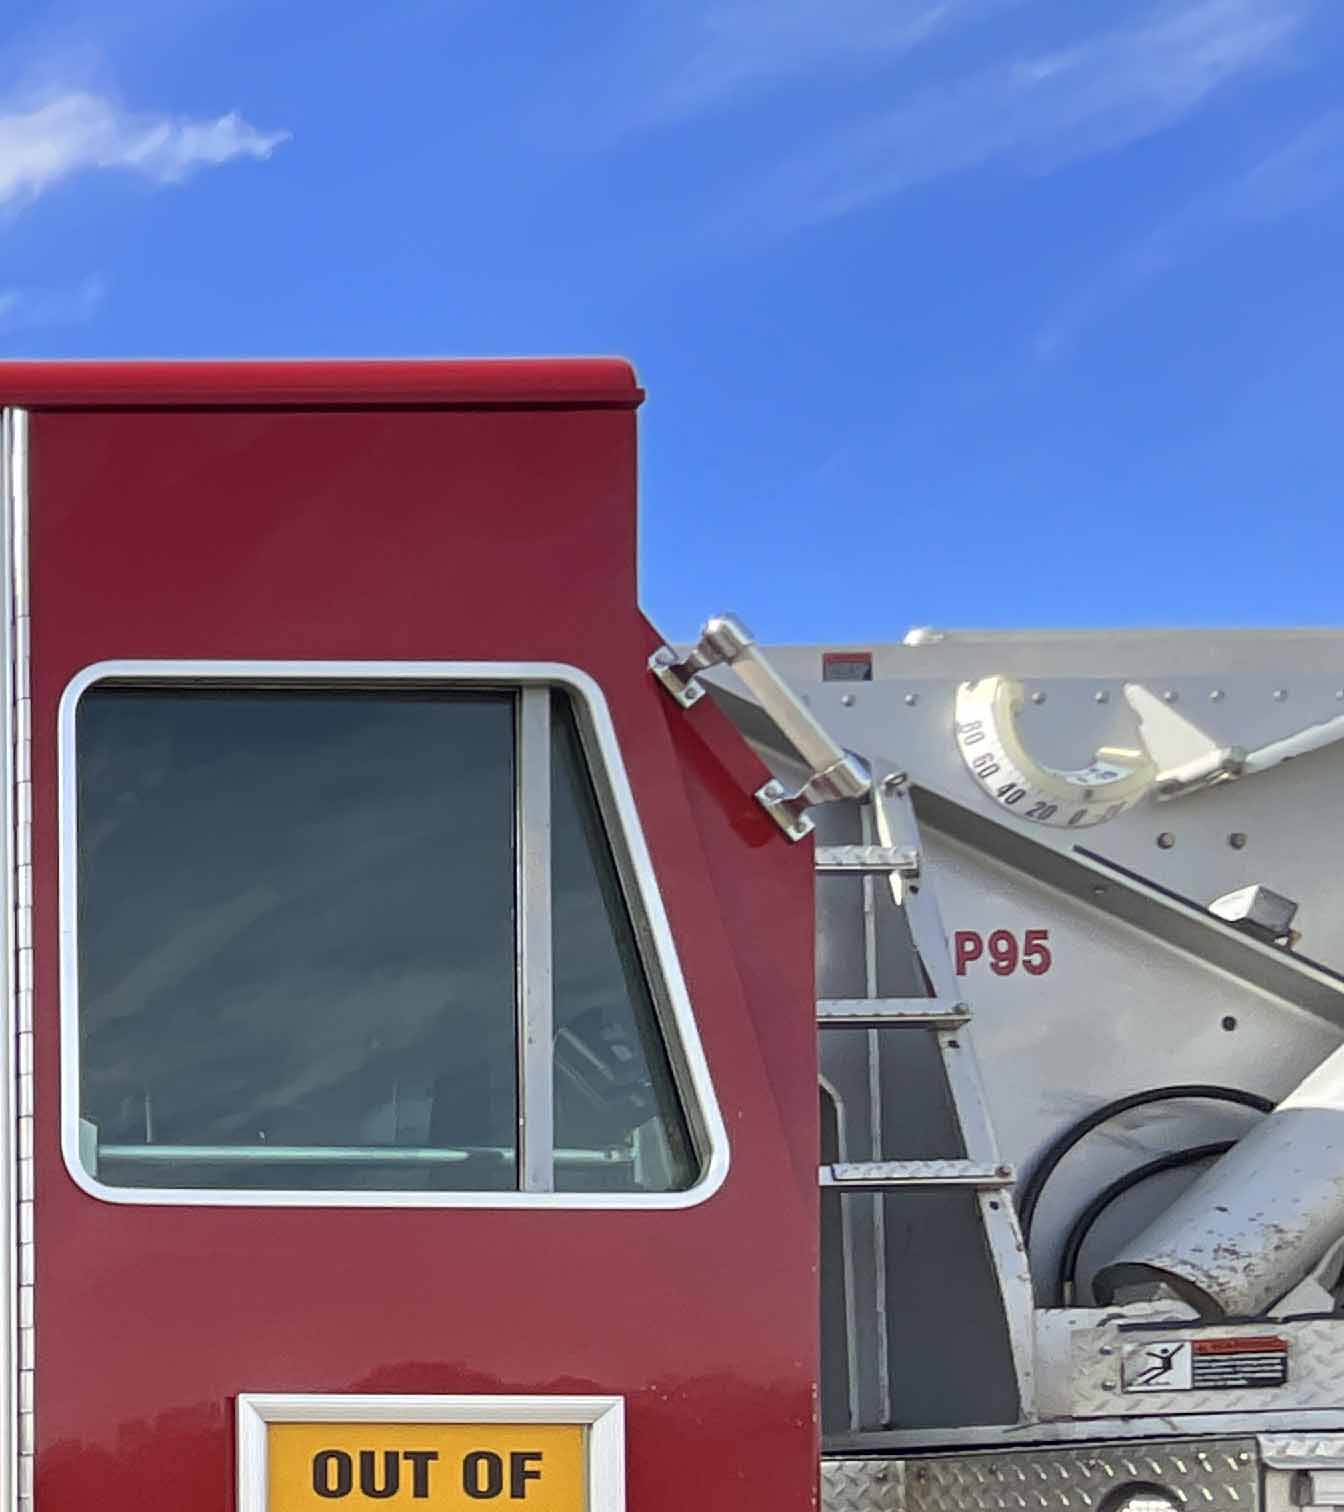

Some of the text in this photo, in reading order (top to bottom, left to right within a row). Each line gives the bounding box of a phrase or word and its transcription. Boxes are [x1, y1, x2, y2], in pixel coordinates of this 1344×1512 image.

[973, 752, 1000, 779] 60
[997, 782, 1027, 805] 40
[1025, 801, 1059, 820] 20
[955, 930, 1052, 976] P95
[312, 1450, 543, 1499] OUT OF
